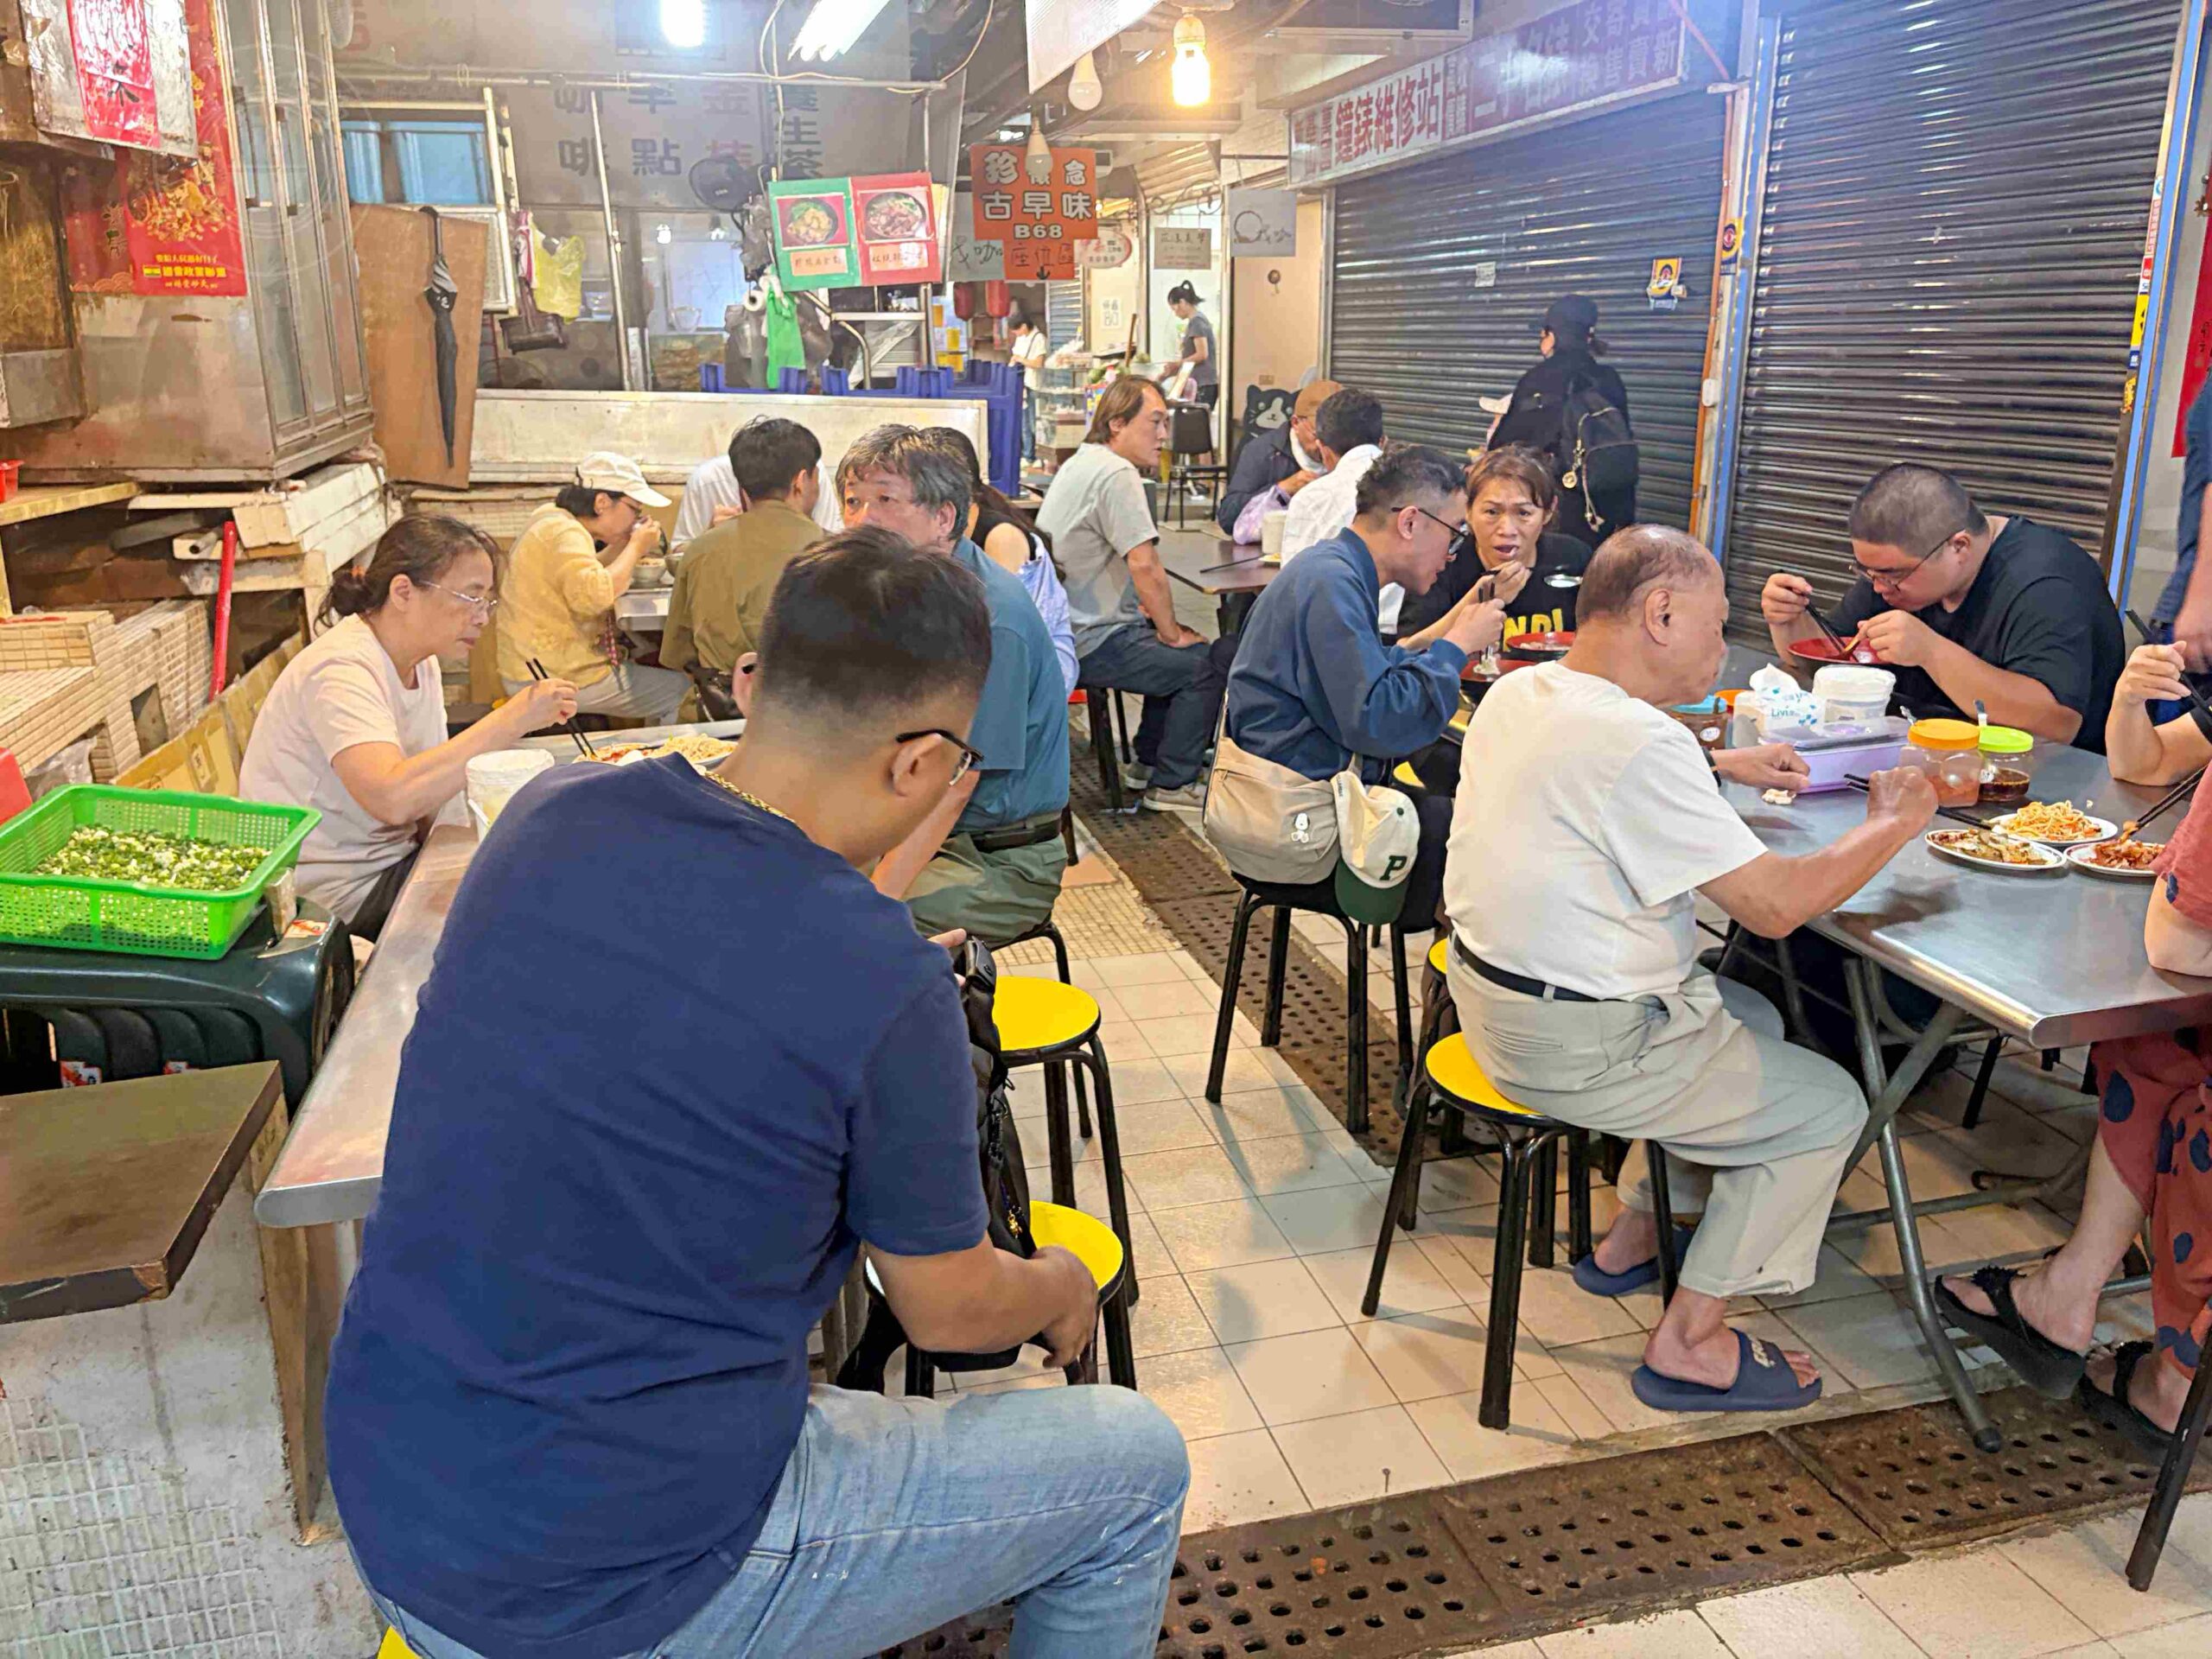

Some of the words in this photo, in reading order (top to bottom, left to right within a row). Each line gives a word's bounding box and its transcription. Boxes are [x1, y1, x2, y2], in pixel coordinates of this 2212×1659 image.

[981, 190, 1093, 220] 古早味
[1014, 224, 1063, 239] B68
[1379, 855, 1408, 880] P
